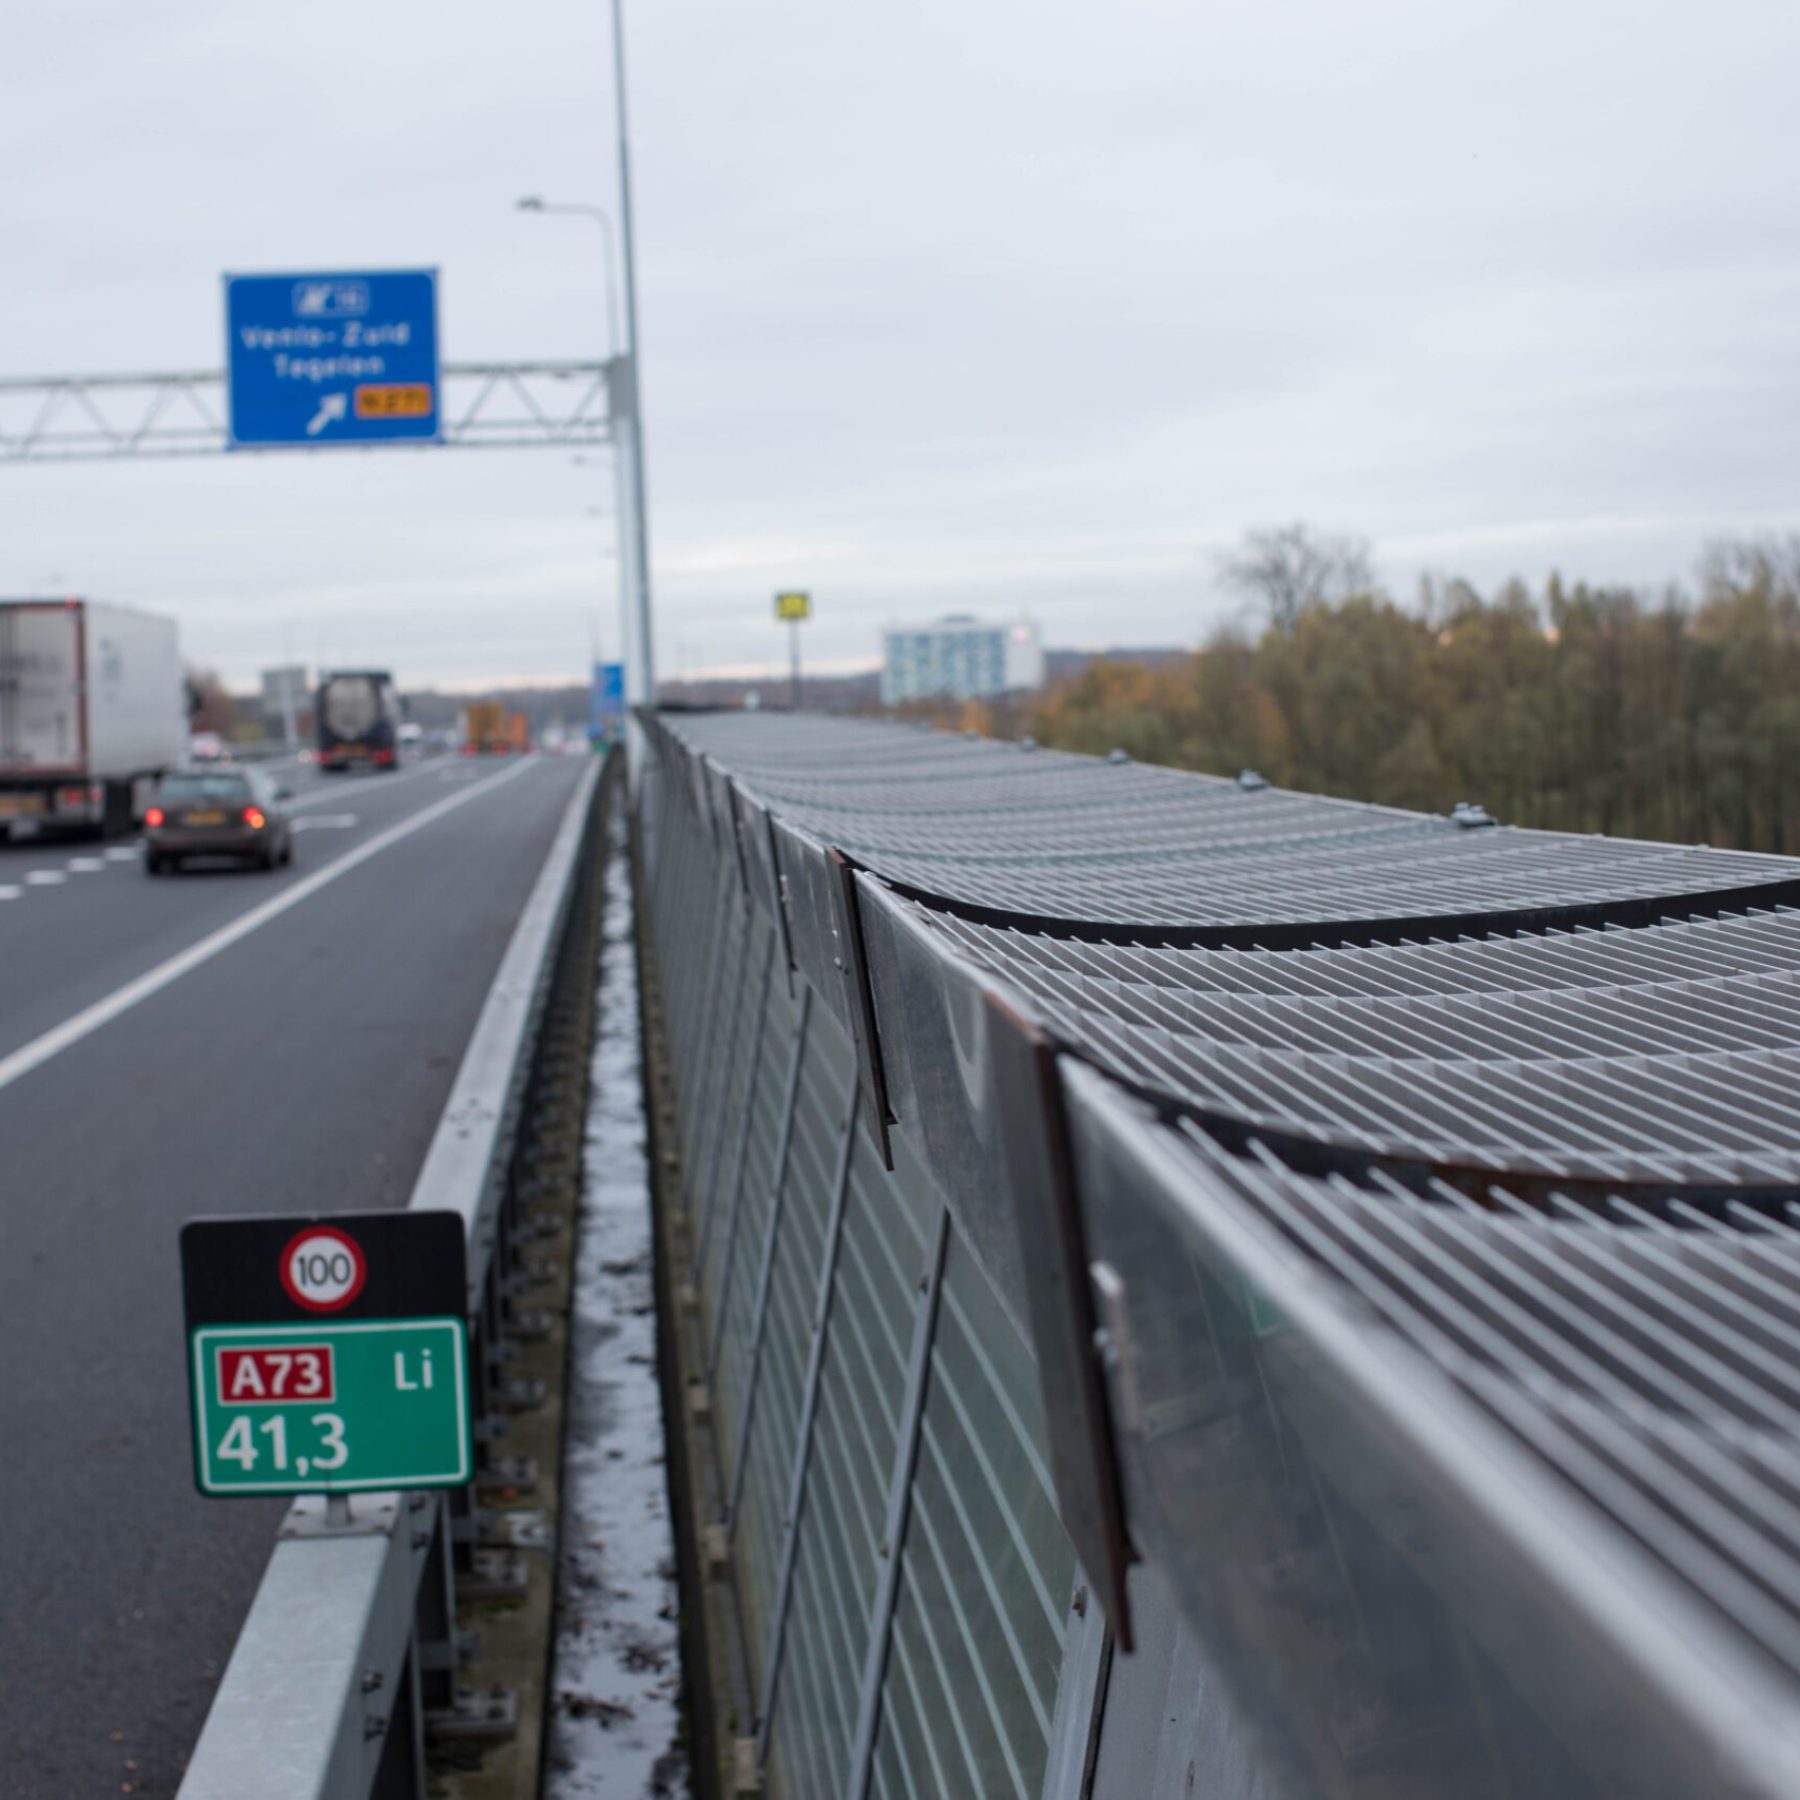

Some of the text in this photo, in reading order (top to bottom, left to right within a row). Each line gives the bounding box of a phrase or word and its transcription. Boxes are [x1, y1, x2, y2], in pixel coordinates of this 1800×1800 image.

[297, 1253, 351, 1286] 100
[231, 1352, 323, 1397] A73
[394, 1348, 433, 1390] Li
[216, 1413, 349, 1478] 41,3
